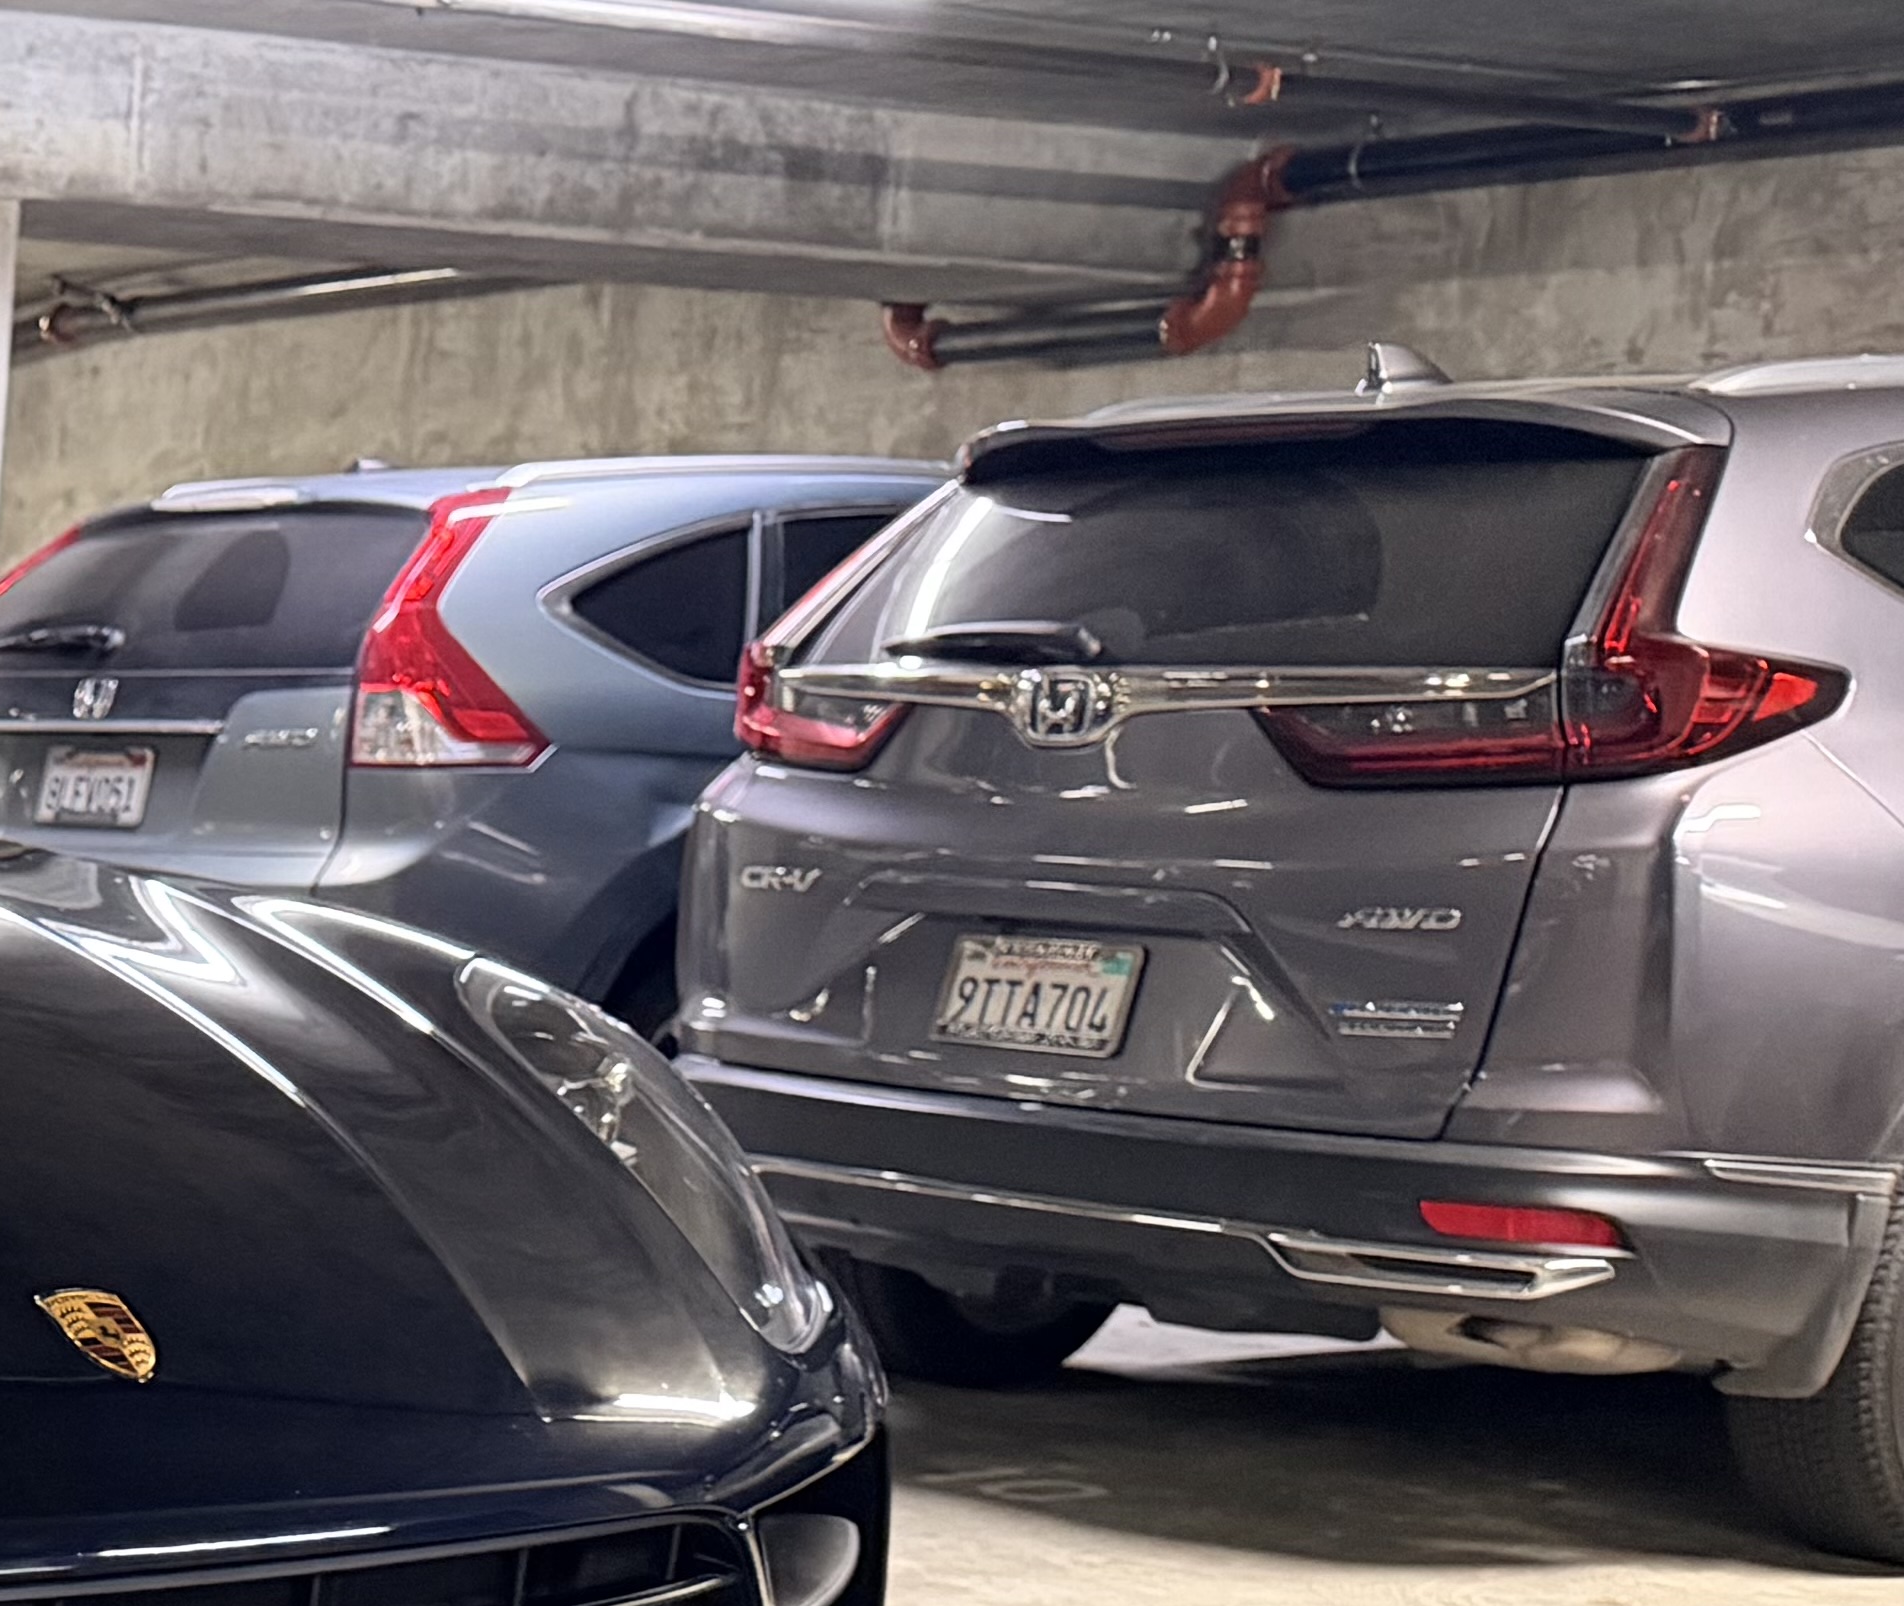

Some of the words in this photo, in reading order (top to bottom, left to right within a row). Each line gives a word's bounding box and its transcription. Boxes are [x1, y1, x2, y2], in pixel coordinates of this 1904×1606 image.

[740, 865, 824, 893] CR-V
[1338, 906, 1462, 930] AWD
[946, 975, 1110, 1034] 9TTA704
